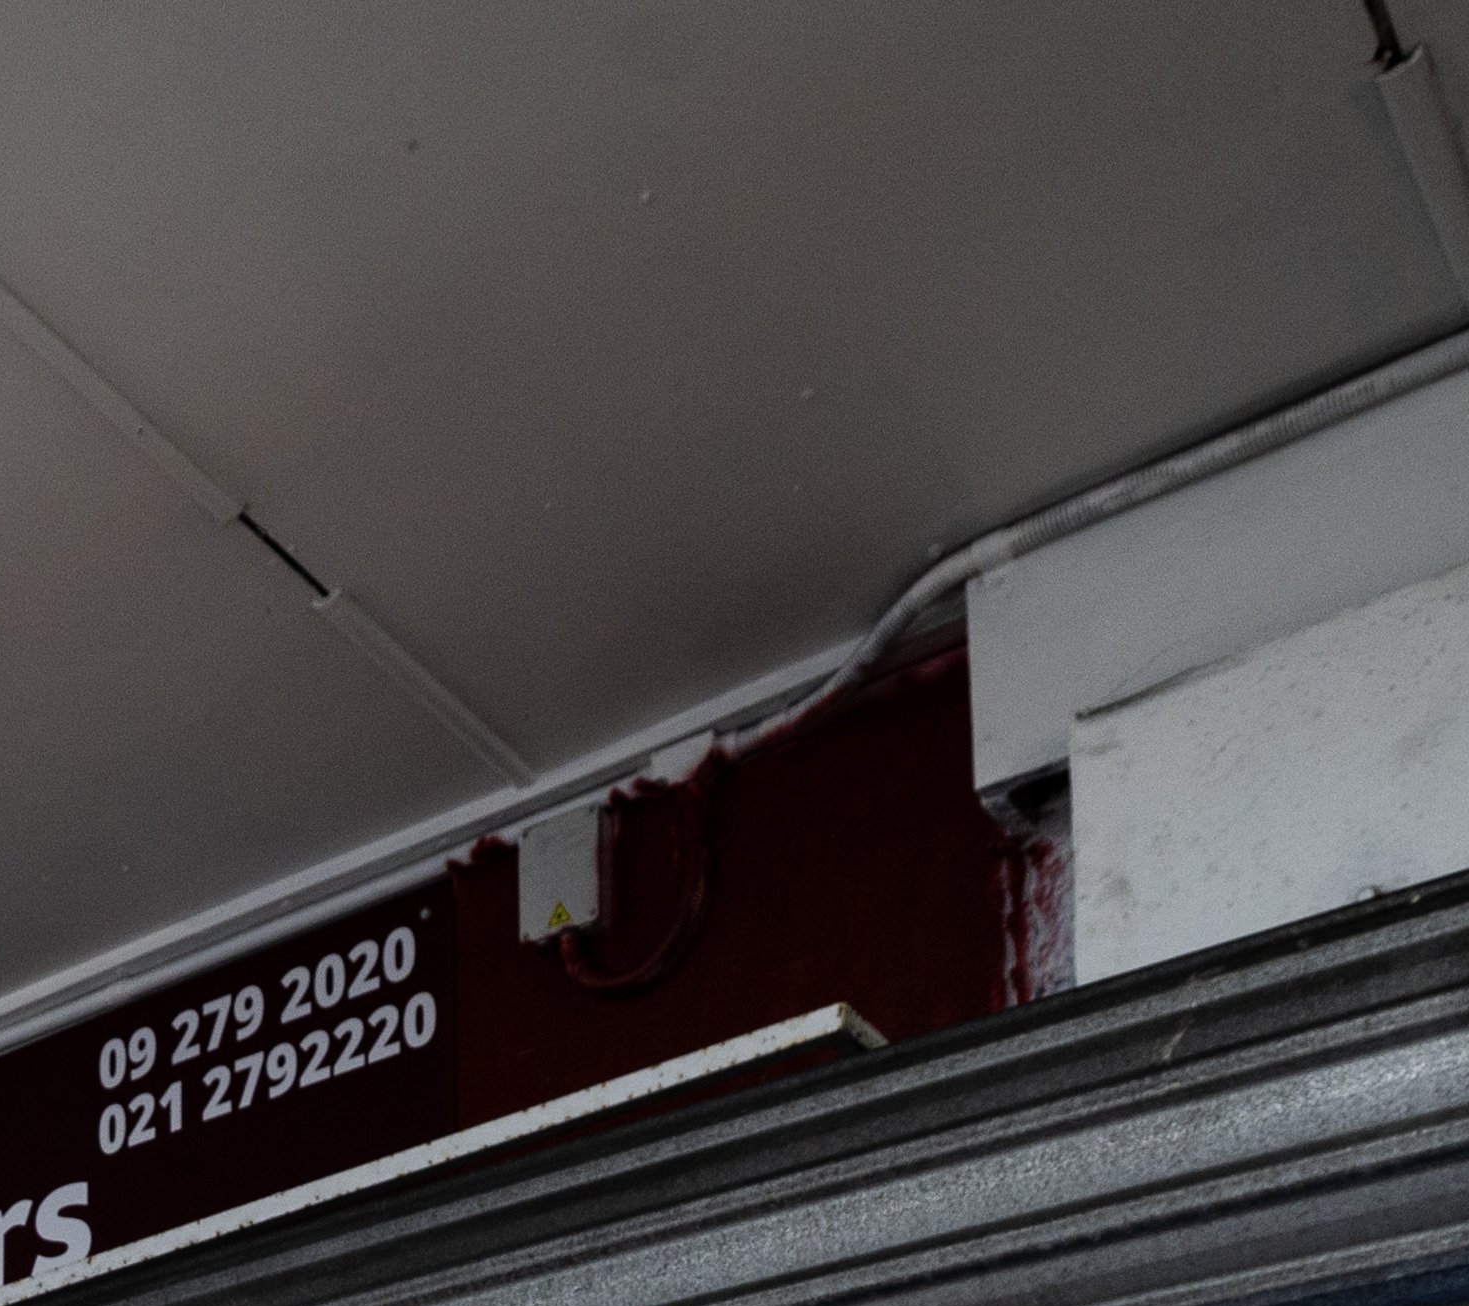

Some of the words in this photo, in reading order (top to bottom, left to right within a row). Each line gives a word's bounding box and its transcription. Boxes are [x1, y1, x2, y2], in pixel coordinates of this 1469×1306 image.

[97, 1026, 158, 1090] 09
[170, 984, 265, 1067] 279
[279, 926, 416, 1025] 2020
[97, 1081, 184, 1156] 021
[201, 991, 438, 1123] 2792220
